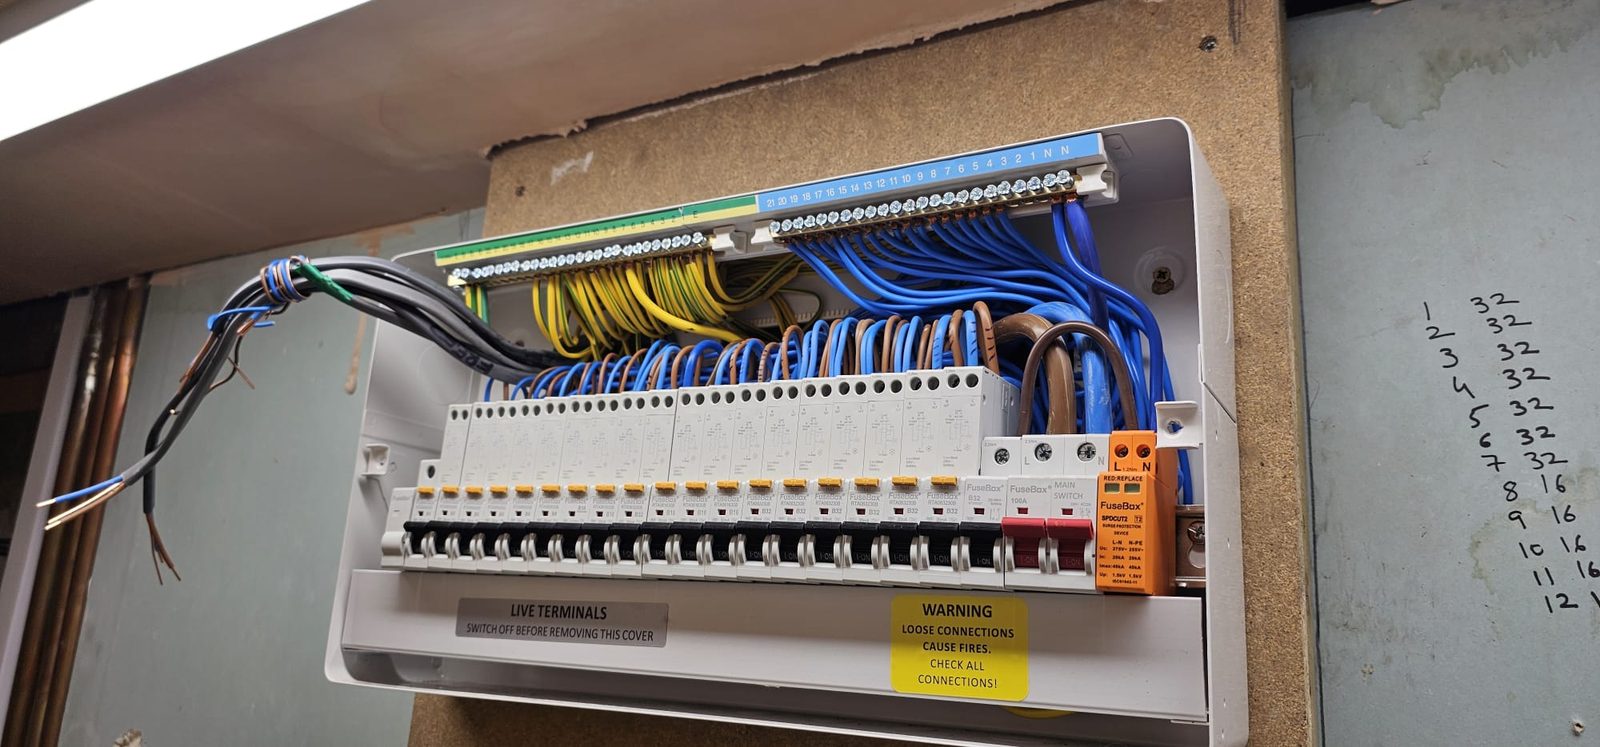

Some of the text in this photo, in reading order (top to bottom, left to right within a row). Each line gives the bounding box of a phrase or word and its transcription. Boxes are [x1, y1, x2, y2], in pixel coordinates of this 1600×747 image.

[767, 146, 1069, 208] 21 20 19 18 17 16 15 14 13 12 11 10 9 8 7 6 5 4 3 2 1 N N
[1424, 292, 1520, 321] 1 32
[1426, 314, 1533, 340] 2 32
[1440, 341, 1540, 369] 3 32
[1453, 367, 1551, 399] 4 32
[1469, 397, 1555, 429] 5 32
[1480, 425, 1556, 449] 6 32
[1098, 456, 1105, 465] N
[1114, 461, 1122, 471] L
[1142, 461, 1151, 472] N
[1481, 452, 1569, 473] 7 32
[1054, 481, 1076, 489] MAIN
[1503, 474, 1566, 502] 8 16
[1054, 492, 1084, 500] SWITCH
[1509, 505, 1577, 529] 9 16
[1519, 535, 1587, 559] 10 16
[1533, 561, 1600, 586] 11 16
[511, 604, 607, 620] LIVE TERMINALS
[922, 603, 993, 618] WARNING
[1545, 593, 1579, 614] 12
[466, 623, 654, 642] SWITCH OFF BEFORE REMOVING THIS COVER
[902, 624, 1015, 638] LOOSE CONNECTIONS
[923, 641, 992, 654] CAUSE FIRES.
[930, 659, 985, 671] CHECK ALL
[918, 674, 997, 689] CONNECTIONS!
